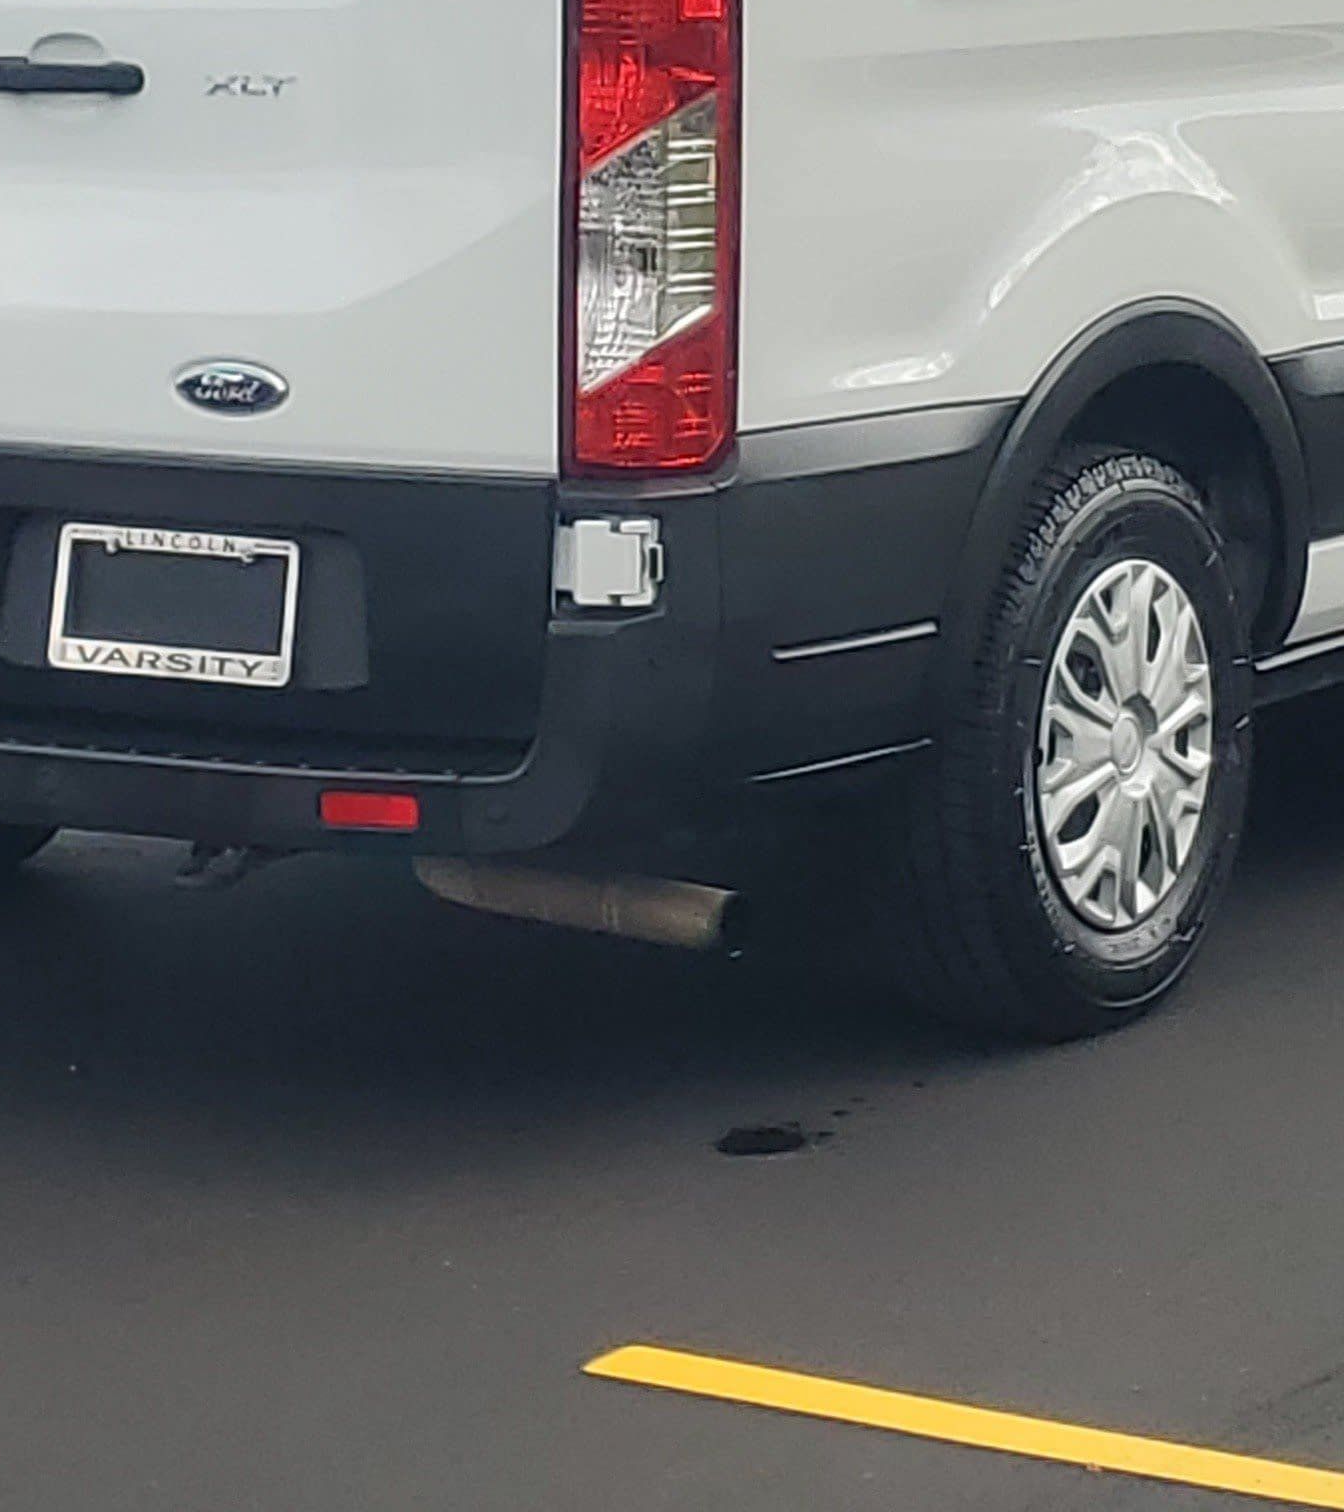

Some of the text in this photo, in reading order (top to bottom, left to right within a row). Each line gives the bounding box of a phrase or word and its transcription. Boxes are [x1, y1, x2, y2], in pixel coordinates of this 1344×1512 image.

[205, 75, 299, 96] XLT
[194, 372, 260, 403] Ford
[125, 532, 236, 554] LINCOLN
[77, 645, 262, 678] VARSITY
